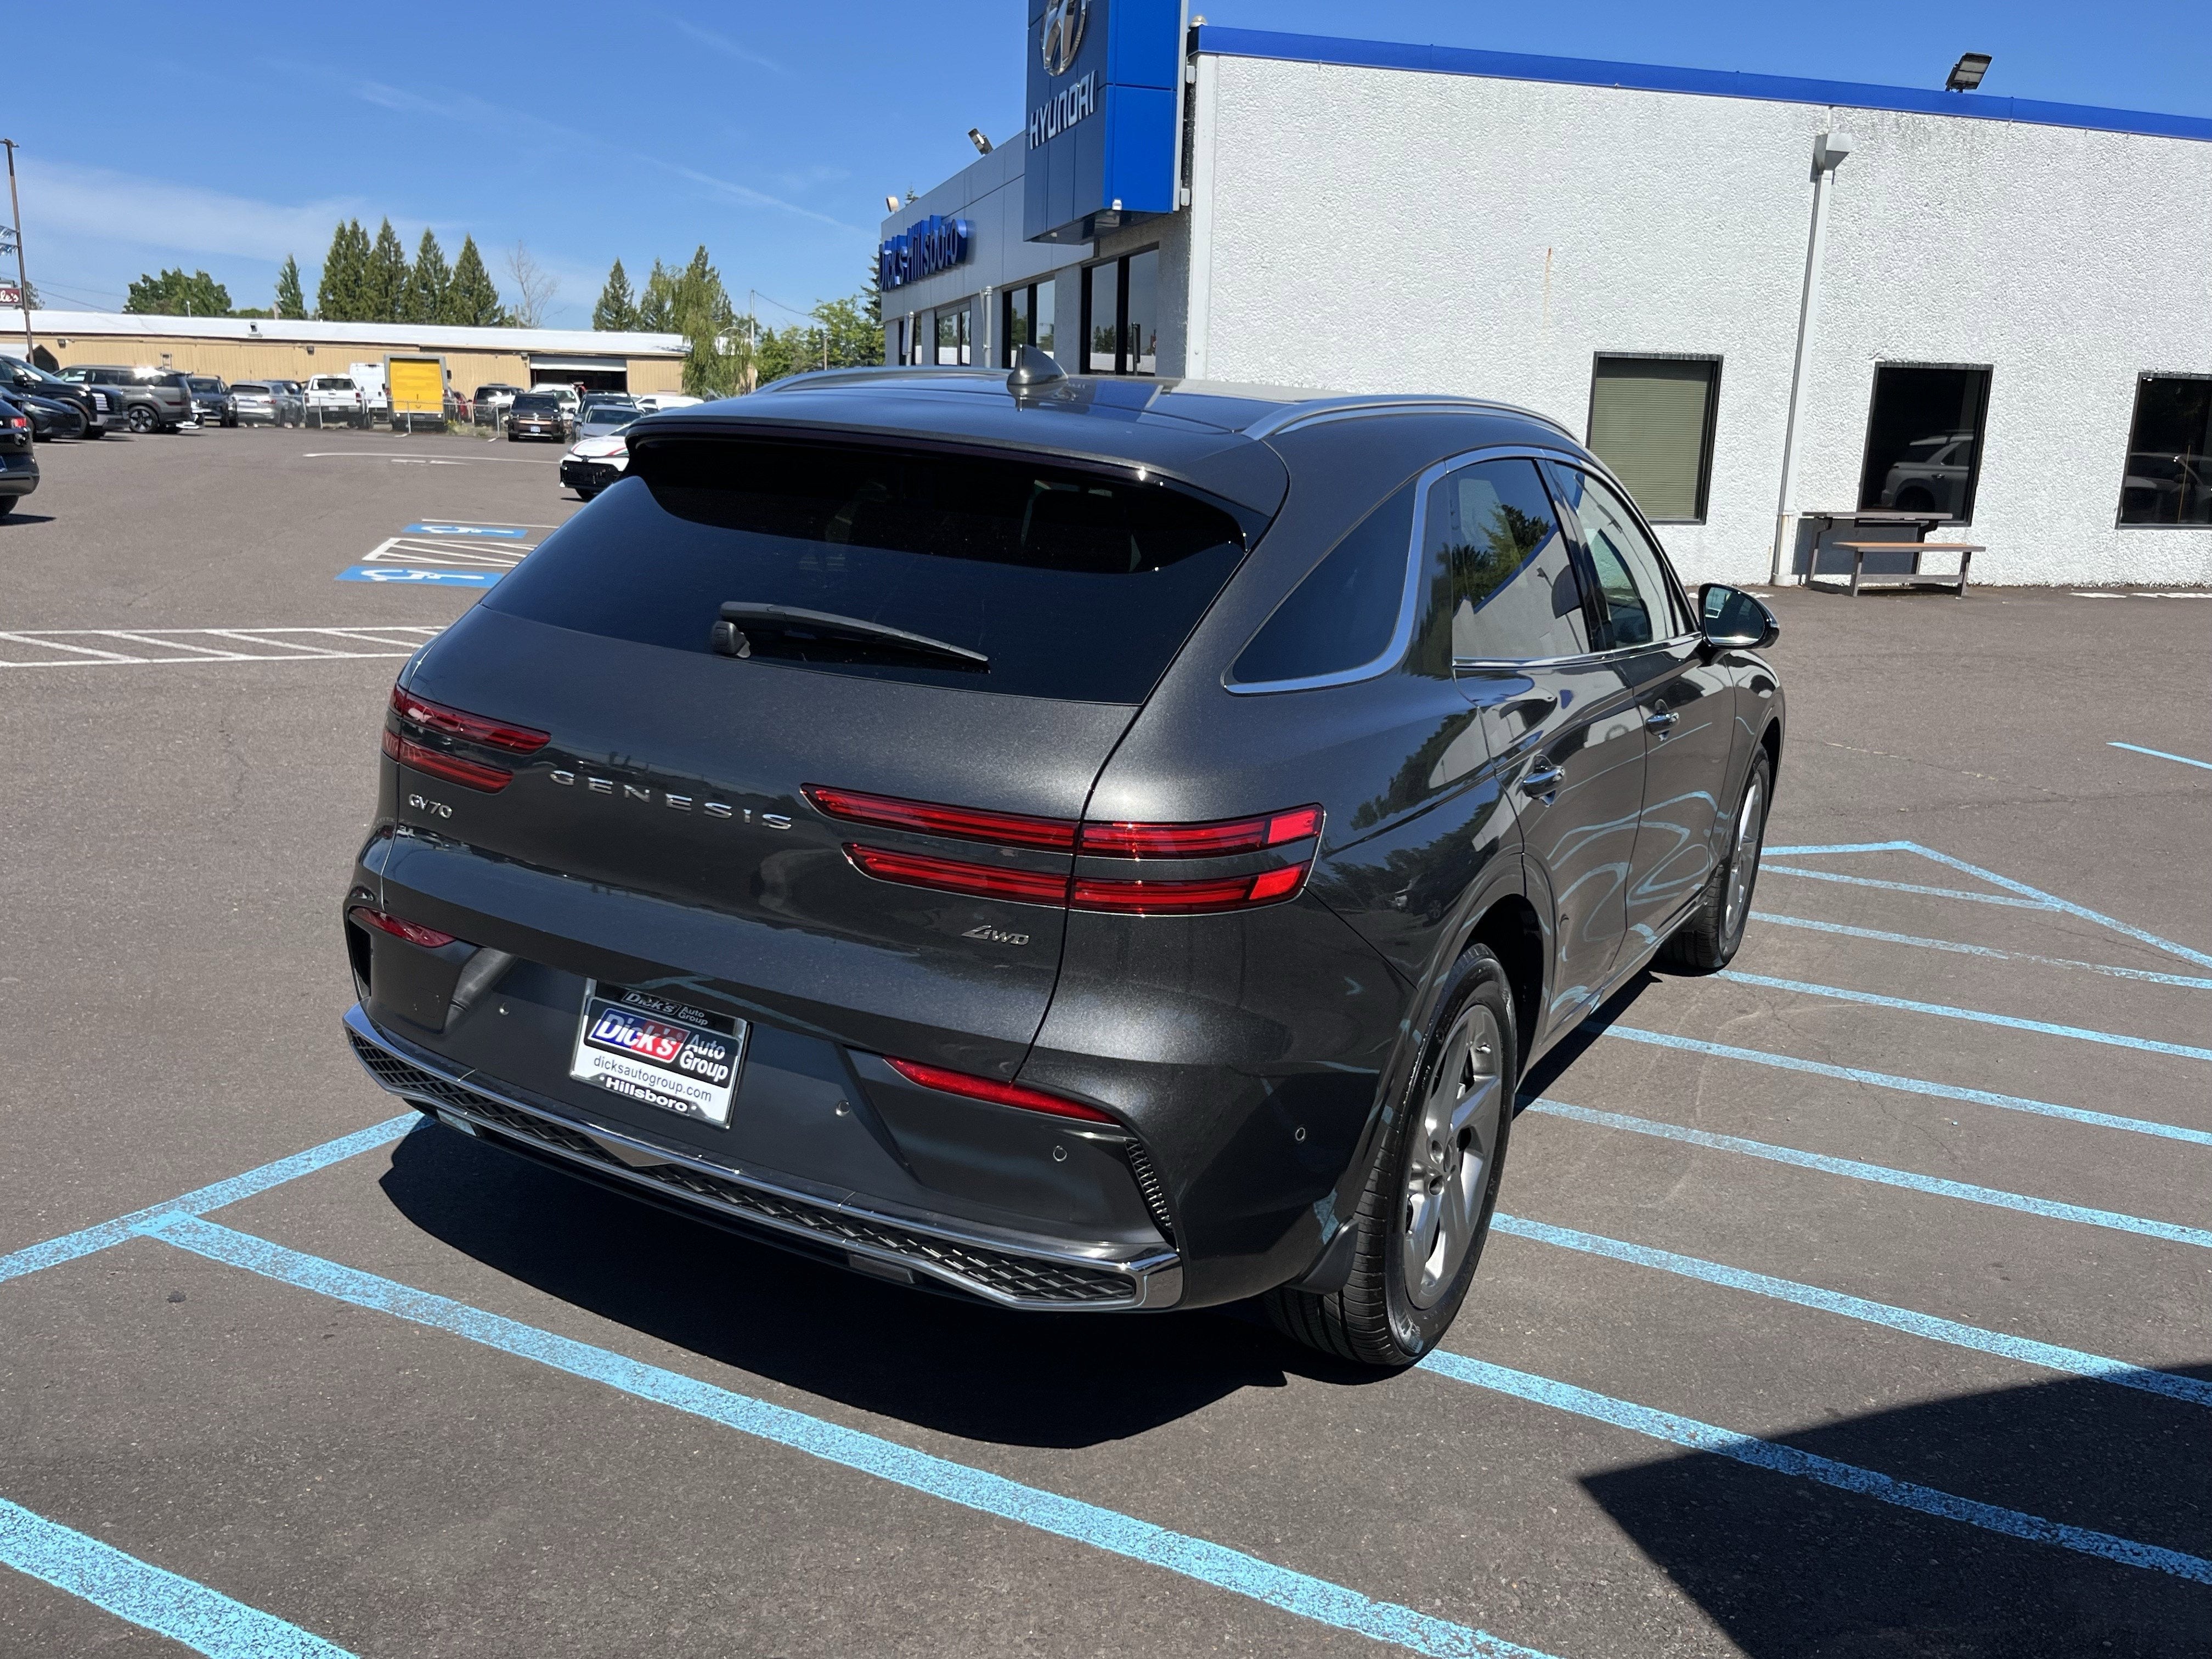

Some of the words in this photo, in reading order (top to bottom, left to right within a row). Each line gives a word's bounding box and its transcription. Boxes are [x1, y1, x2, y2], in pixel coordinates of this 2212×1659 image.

[1030, 70, 1096, 150] HYUNDAI
[907, 215, 964, 282] Hillsboro
[409, 793, 453, 819] GV70
[550, 770, 792, 830] GENESIS
[625, 992, 675, 1013] Dick's
[678, 1011, 709, 1026] Group
[682, 1006, 705, 1018] Auto
[595, 1013, 678, 1057] Dick's
[685, 1034, 726, 1060] Auto
[593, 1054, 713, 1103] dicksautogroup.com
[680, 1050, 729, 1082] Group
[605, 1076, 688, 1112] Hillsboro
